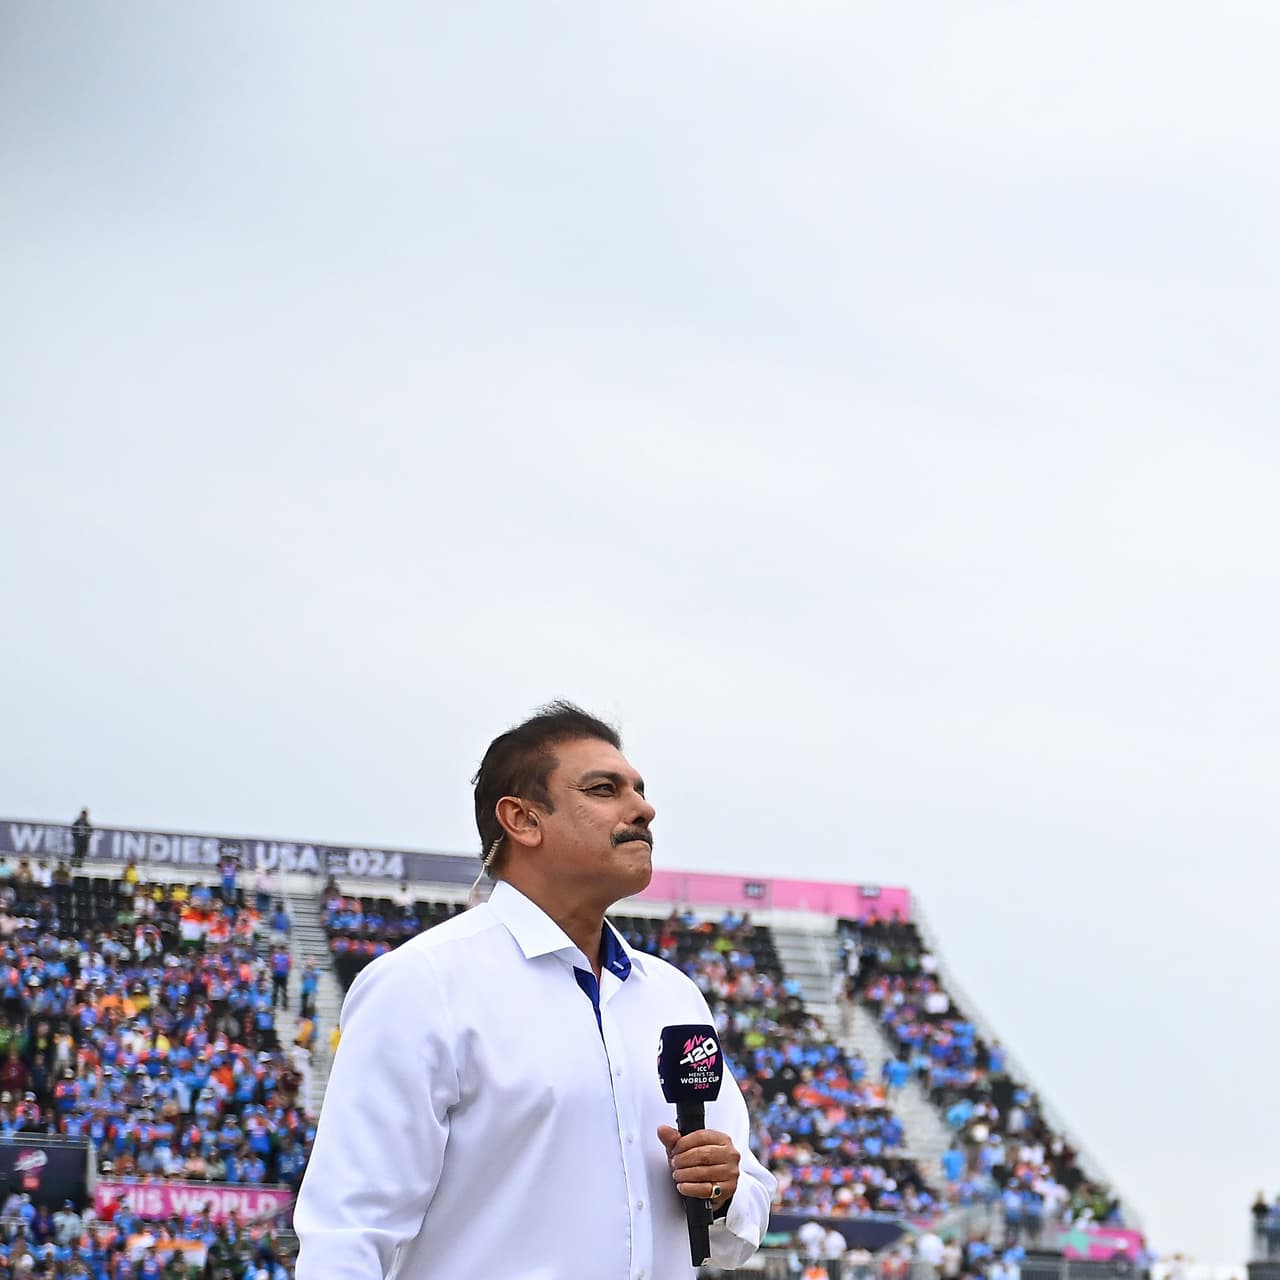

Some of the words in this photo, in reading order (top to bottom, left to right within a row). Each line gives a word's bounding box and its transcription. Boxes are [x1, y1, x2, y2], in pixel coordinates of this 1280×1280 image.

[112, 830, 220, 864] INDIES
[256, 841, 320, 872] USA
[680, 1037, 718, 1064] T20
[170, 1187, 279, 1222] WORLD
